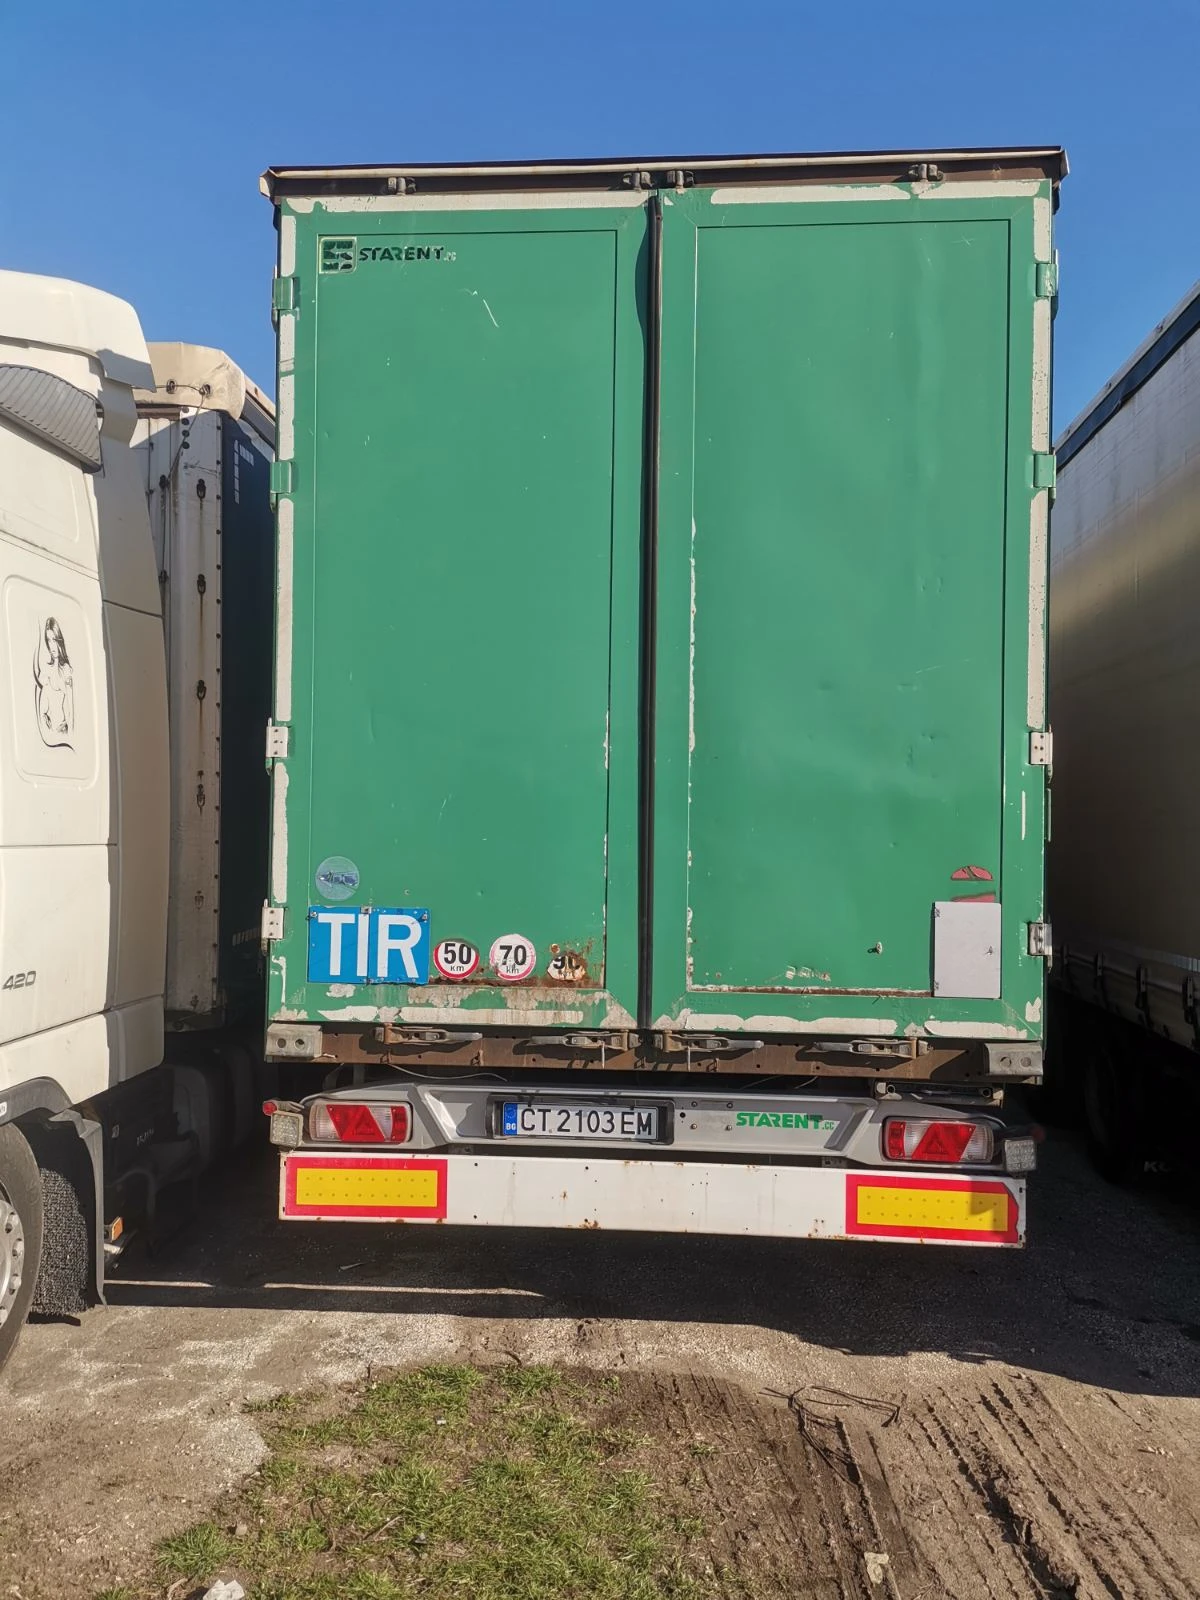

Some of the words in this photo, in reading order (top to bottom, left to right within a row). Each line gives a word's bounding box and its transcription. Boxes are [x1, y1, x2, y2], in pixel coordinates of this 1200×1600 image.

[317, 913, 422, 978] TIR
[444, 943, 471, 964] 50
[499, 945, 527, 966] 70
[2, 970, 36, 990] 420
[506, 1123, 516, 1131] BG
[521, 1108, 551, 1132] CT
[557, 1110, 615, 1134] 2103
[621, 1112, 651, 1136] EM
